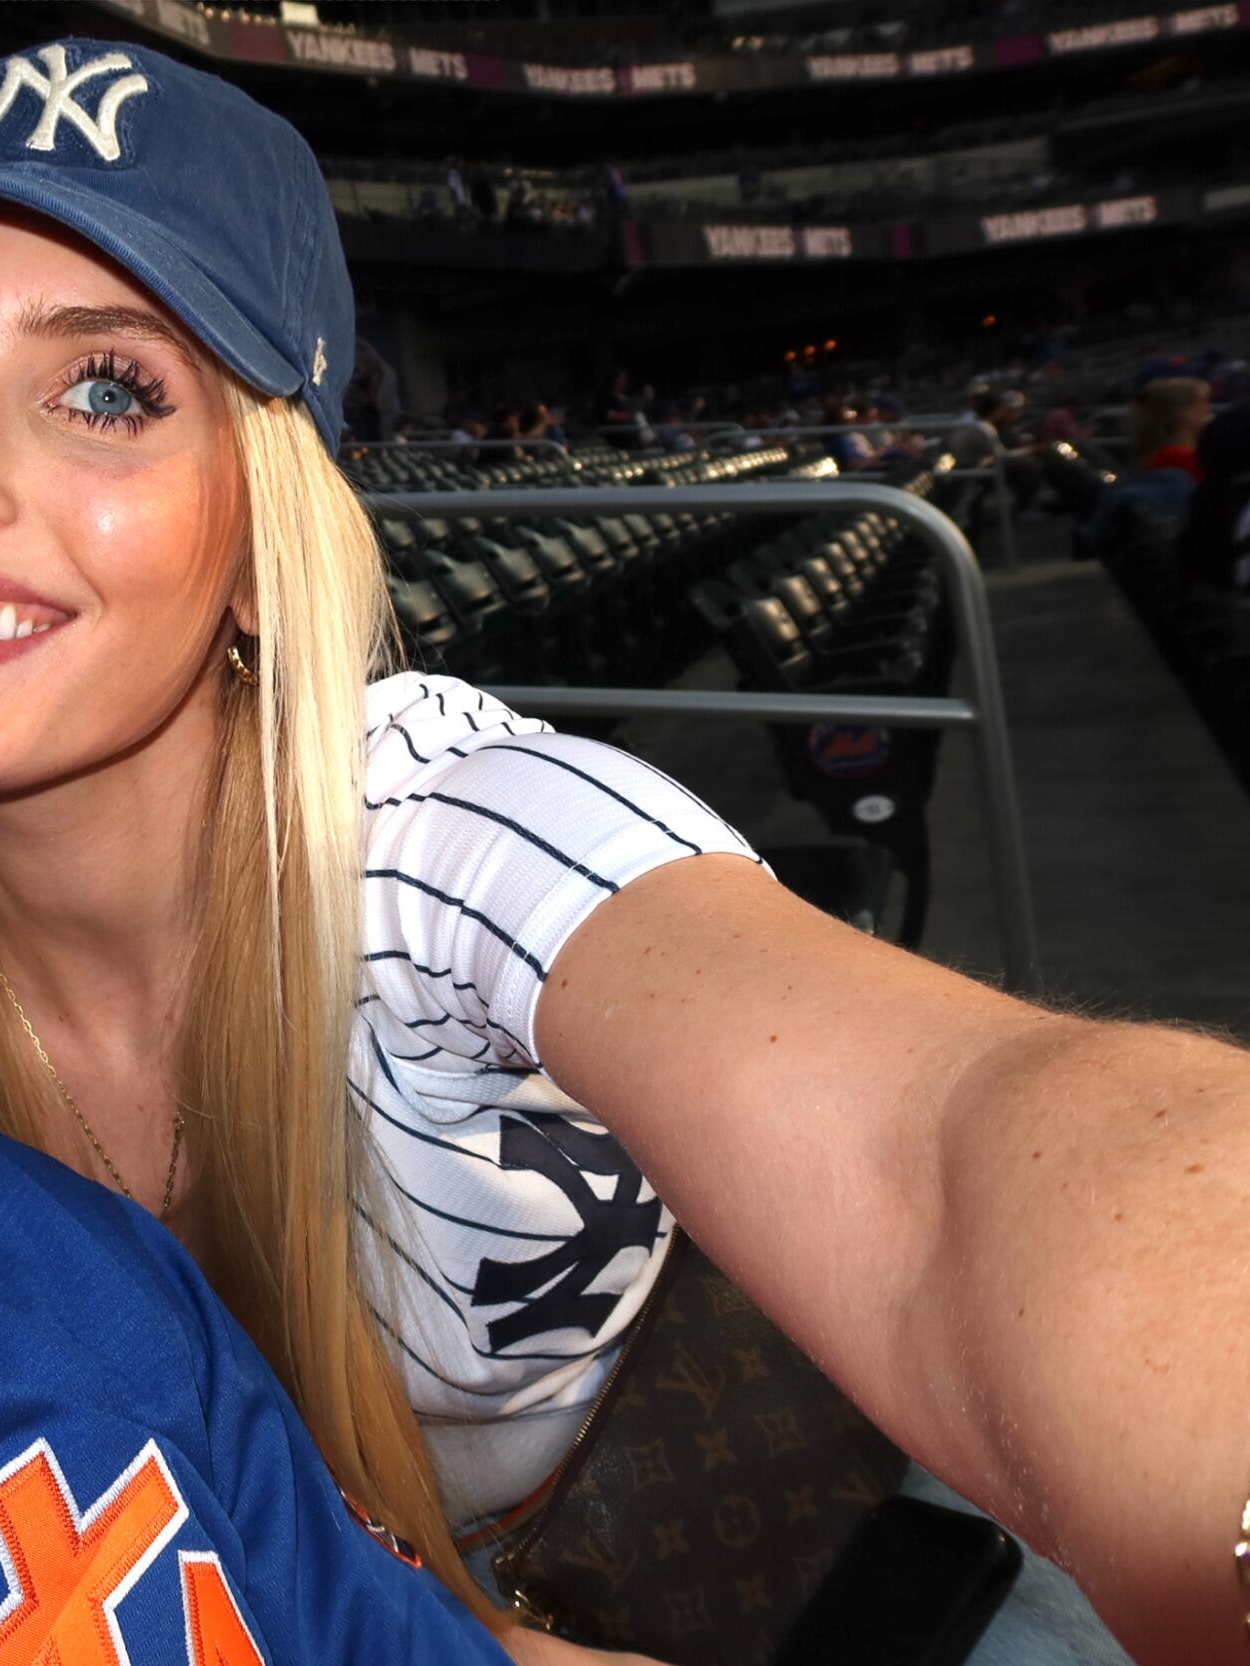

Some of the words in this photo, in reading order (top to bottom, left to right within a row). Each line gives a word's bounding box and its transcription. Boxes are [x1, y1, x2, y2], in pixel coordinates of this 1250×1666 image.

[286, 30, 396, 71] YANKEES
[410, 47, 468, 80] METS
[910, 44, 974, 73] METS
[524, 64, 615, 92] YANKEES
[634, 63, 696, 89] METS
